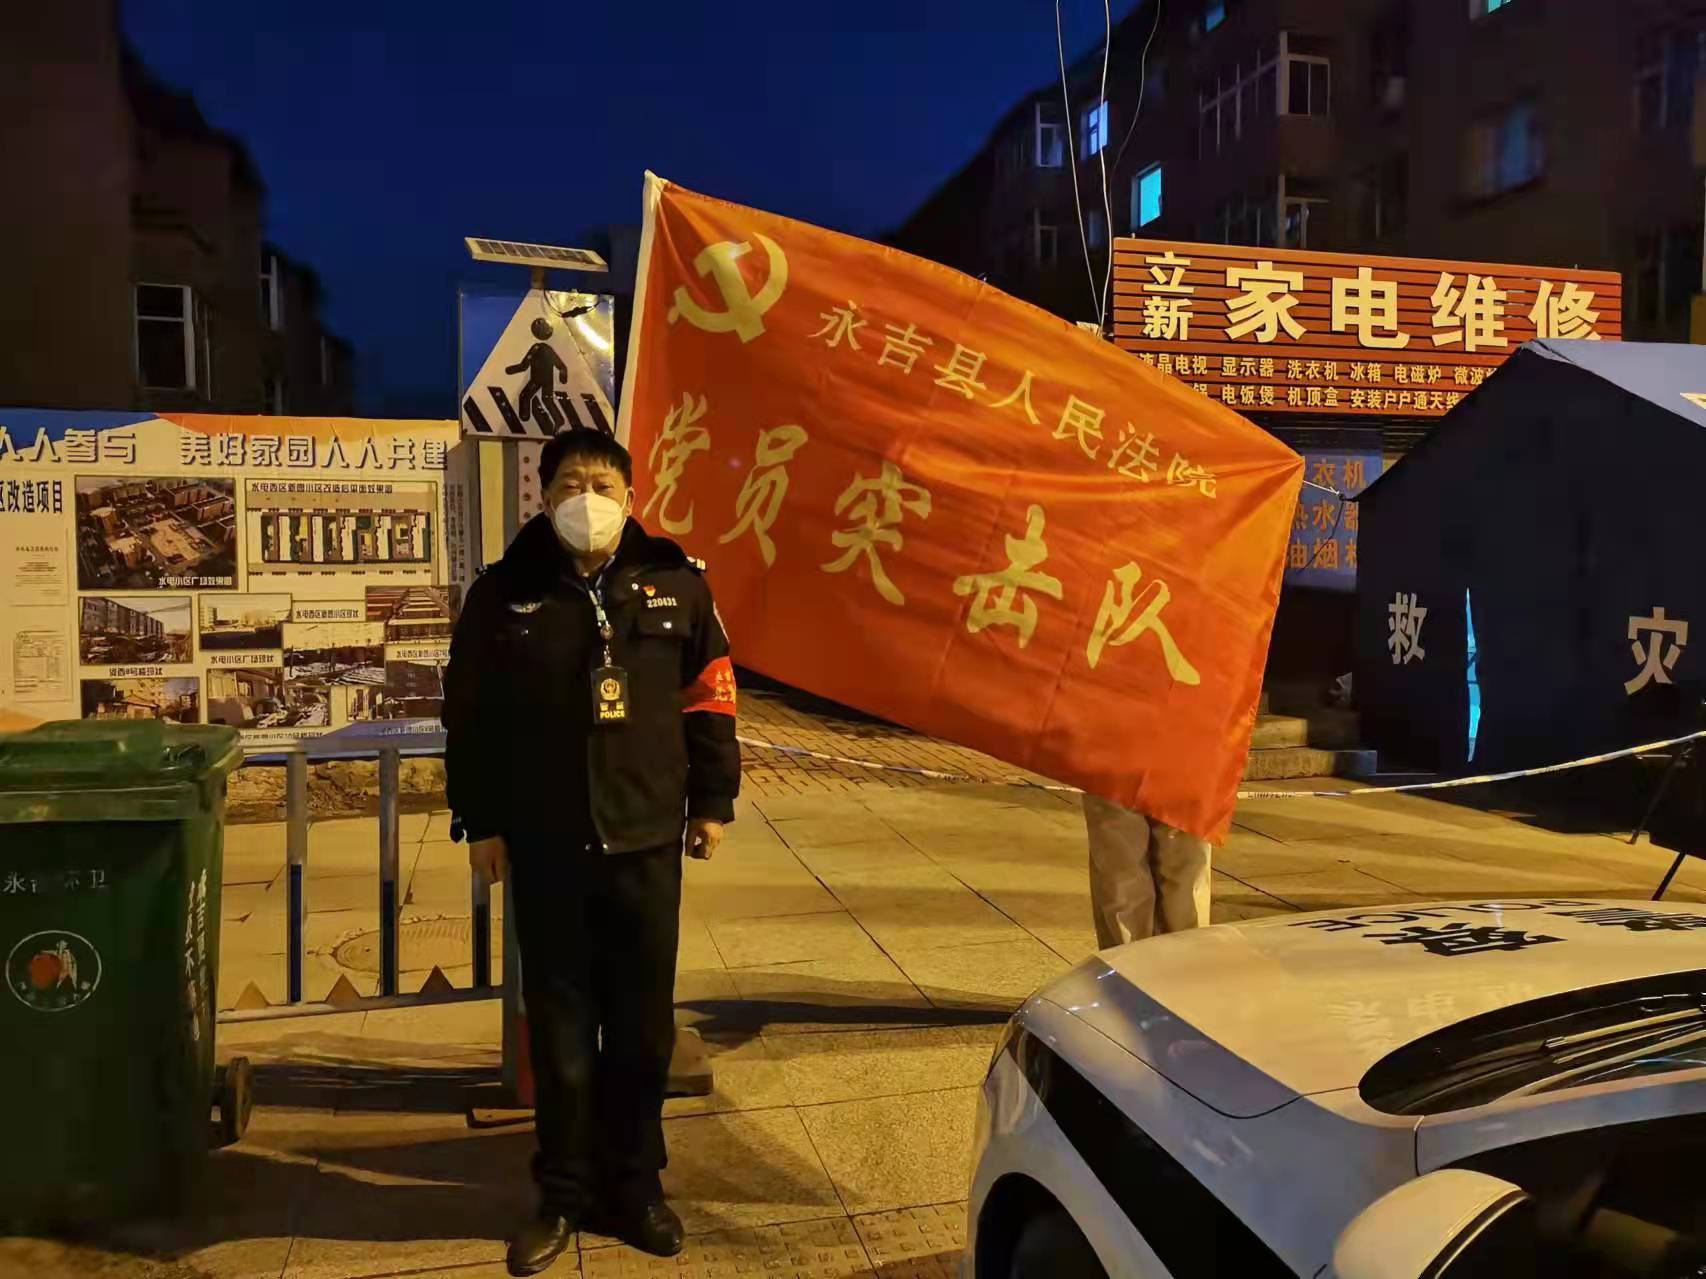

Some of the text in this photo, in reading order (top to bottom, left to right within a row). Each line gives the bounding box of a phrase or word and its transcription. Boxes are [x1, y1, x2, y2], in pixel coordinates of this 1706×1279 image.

[1142, 251, 1194, 341] 立新
[1224, 261, 1602, 352] 家电维修
[1222, 356, 1274, 377] 显示器
[1288, 359, 1339, 381] 洗衣机
[1350, 362, 1381, 383] 冰箱
[1395, 364, 1441, 385] 电磁炉
[808, 300, 1217, 499] 永吉县人民法院
[1222, 384, 1274, 405] 电饭煲
[1288, 386, 1339, 407] 机顶盒
[1350, 388, 1465, 410] 安装户户通天线
[180, 432, 449, 470] 美好家园人人共建
[1304, 458, 1367, 491] 衣机
[642, 391, 1200, 685] 党员突击队
[1288, 900, 1602, 932] POLICE
